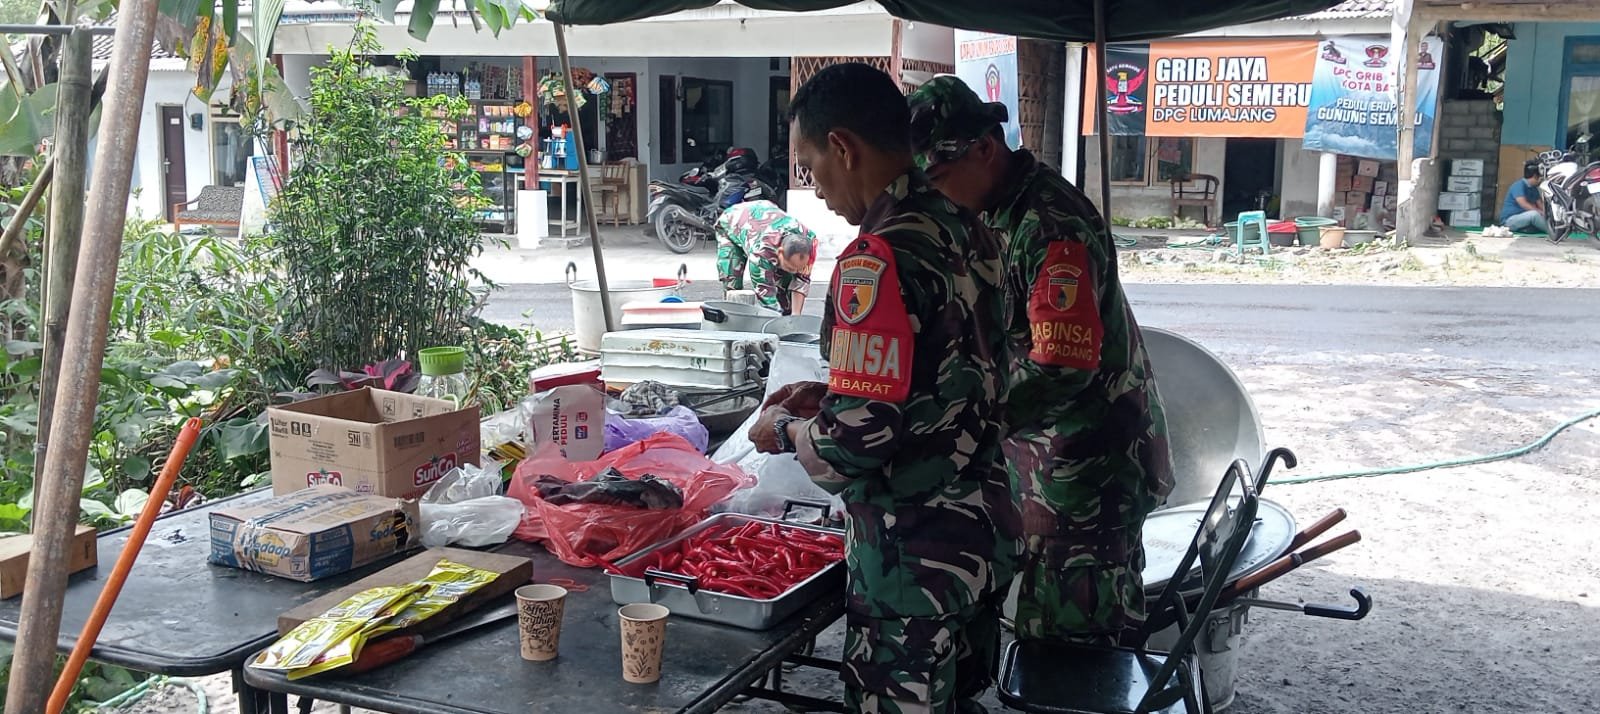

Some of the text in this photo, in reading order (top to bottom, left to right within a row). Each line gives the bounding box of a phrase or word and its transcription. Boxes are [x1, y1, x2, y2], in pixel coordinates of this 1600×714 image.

[1156, 57, 1268, 82] GRIB JAYA
[1356, 71, 1383, 81] GRIB
[1154, 83, 1313, 107] PEDULI SEMERU
[1337, 98, 1397, 113] PEDULI ERUP
[1153, 108, 1276, 122] DPC LUMAJANG
[1317, 107, 1423, 126] GUNUNG SEMU
[830, 328, 900, 379] BINSA
[1045, 343, 1093, 361] PADANG
[842, 379, 892, 395] BARAT
[348, 433, 361, 444] SNI
[560, 415, 568, 446] PEDULI
[416, 457, 455, 485] SunCo
